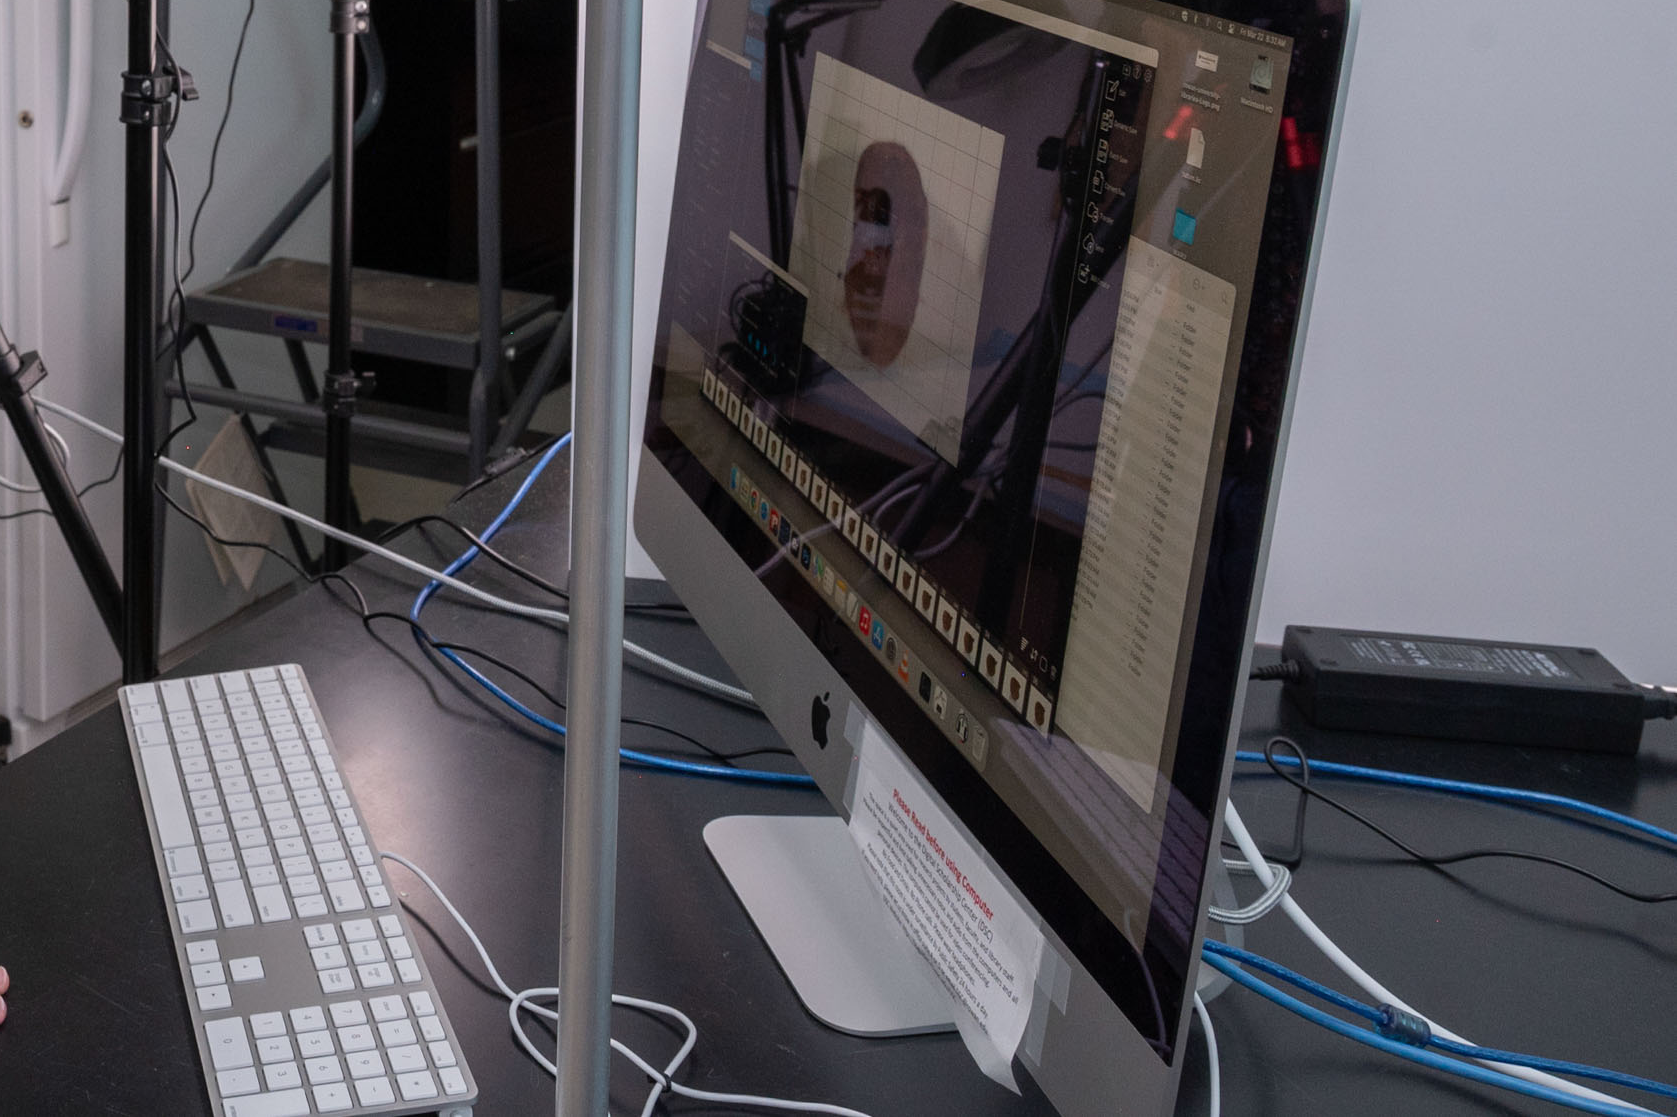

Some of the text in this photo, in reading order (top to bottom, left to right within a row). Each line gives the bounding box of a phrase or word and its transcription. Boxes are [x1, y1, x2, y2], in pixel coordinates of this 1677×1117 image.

[893, 788, 992, 919] Please Read before using Computer
[888, 802, 993, 943] Welcome to the Digital Scholarship Center (DSC)
[961, 933, 972, 948] from
[971, 946, 979, 958] the
[978, 956, 1001, 986] computers
[1002, 984, 1012, 997] and
[979, 941, 988, 953] and
[988, 951, 1002, 971] library
[958, 976, 965, 987] 24
[964, 984, 976, 1003] hours
[979, 1005, 987, 1018] day
[268, 1043, 280, 1051] 2
[309, 1038, 321, 1046] 5
[317, 1064, 329, 1072] 6
[358, 1058, 371, 1066] 9
